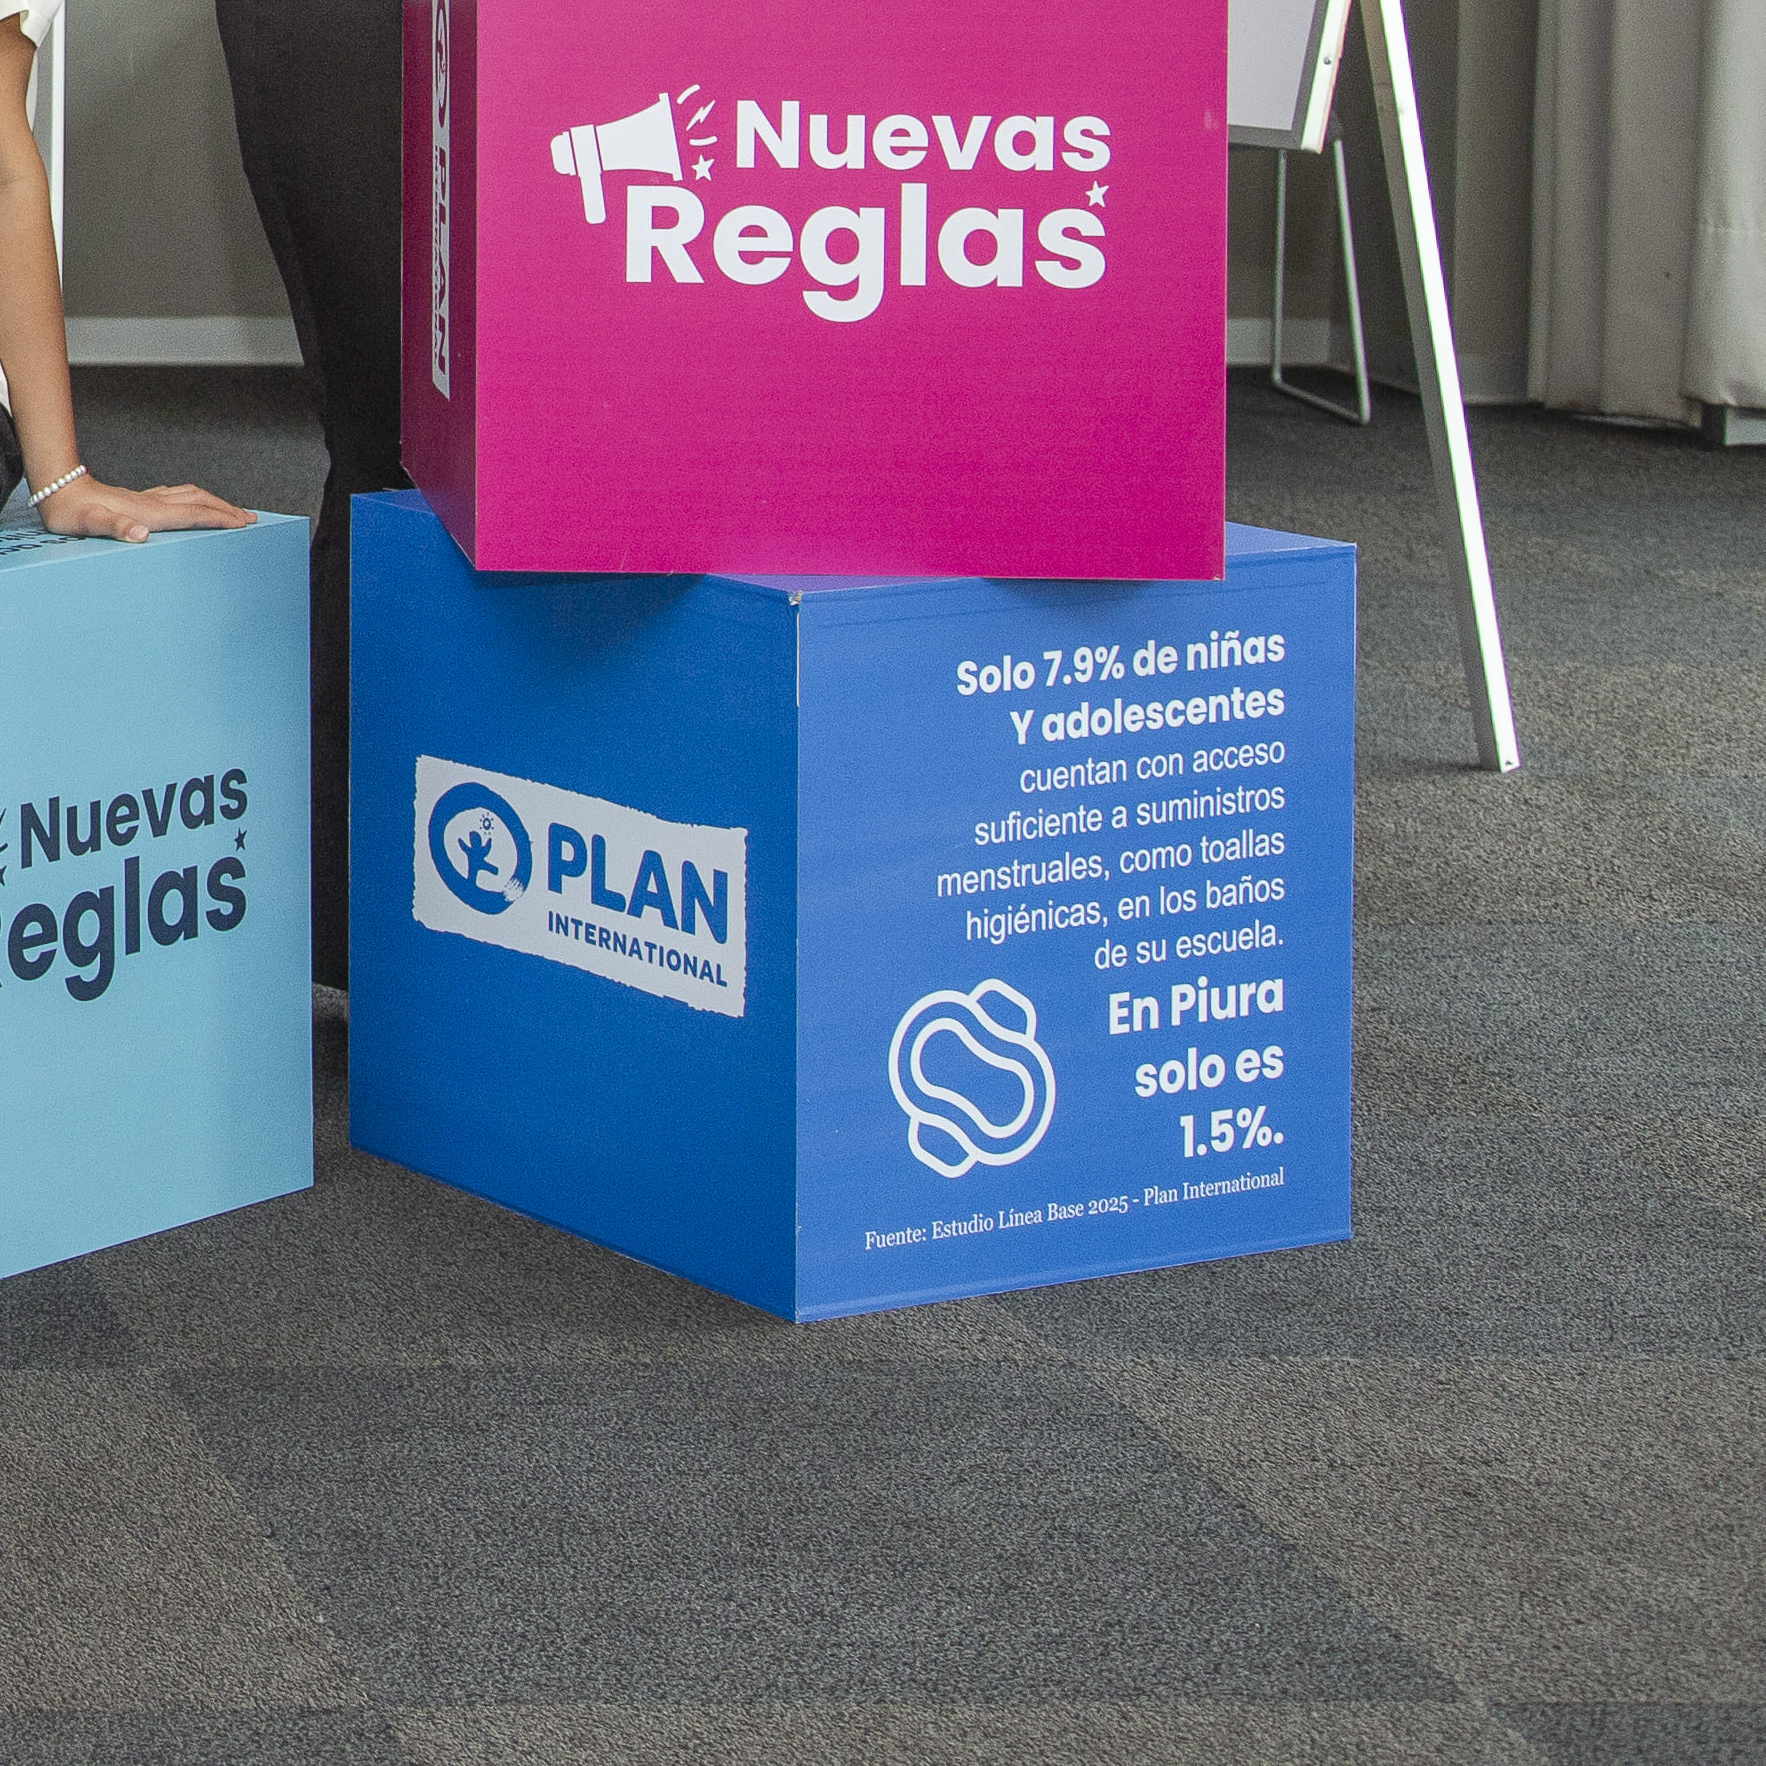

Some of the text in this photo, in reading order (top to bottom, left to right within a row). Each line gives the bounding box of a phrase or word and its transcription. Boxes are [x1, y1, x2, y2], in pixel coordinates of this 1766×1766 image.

[736, 99, 1111, 173] Nuevas
[626, 183, 1107, 323] Reglas
[956, 630, 1286, 696] Solo 7.9% de niñas
[1009, 687, 1286, 745] Y adolescentes
[1019, 740, 1286, 794] cuentan con acceso
[19, 767, 248, 870] Nuevas
[974, 785, 1286, 846] suficiente a suministros
[548, 822, 728, 945] PLAN
[937, 828, 1286, 897] menstruales, como toallas
[966, 874, 1286, 945] higiénicas, en los baños
[548, 910, 728, 988] INTERNATIONAL
[1094, 919, 1285, 970] de su escuela.
[1108, 976, 1285, 1036] En Piura
[1134, 1044, 1285, 1098] solo es
[1179, 1105, 1285, 1158] 1.5%.
[864, 1226, 928, 1251] Fuente:
[931, 1211, 994, 1240] Estudio
[998, 1206, 1043, 1230] Línea
[1047, 1200, 1085, 1222] Base
[1088, 1195, 1129, 1216] 2025
[1143, 1186, 1179, 1208] Plan
[1182, 1167, 1286, 1201] International
